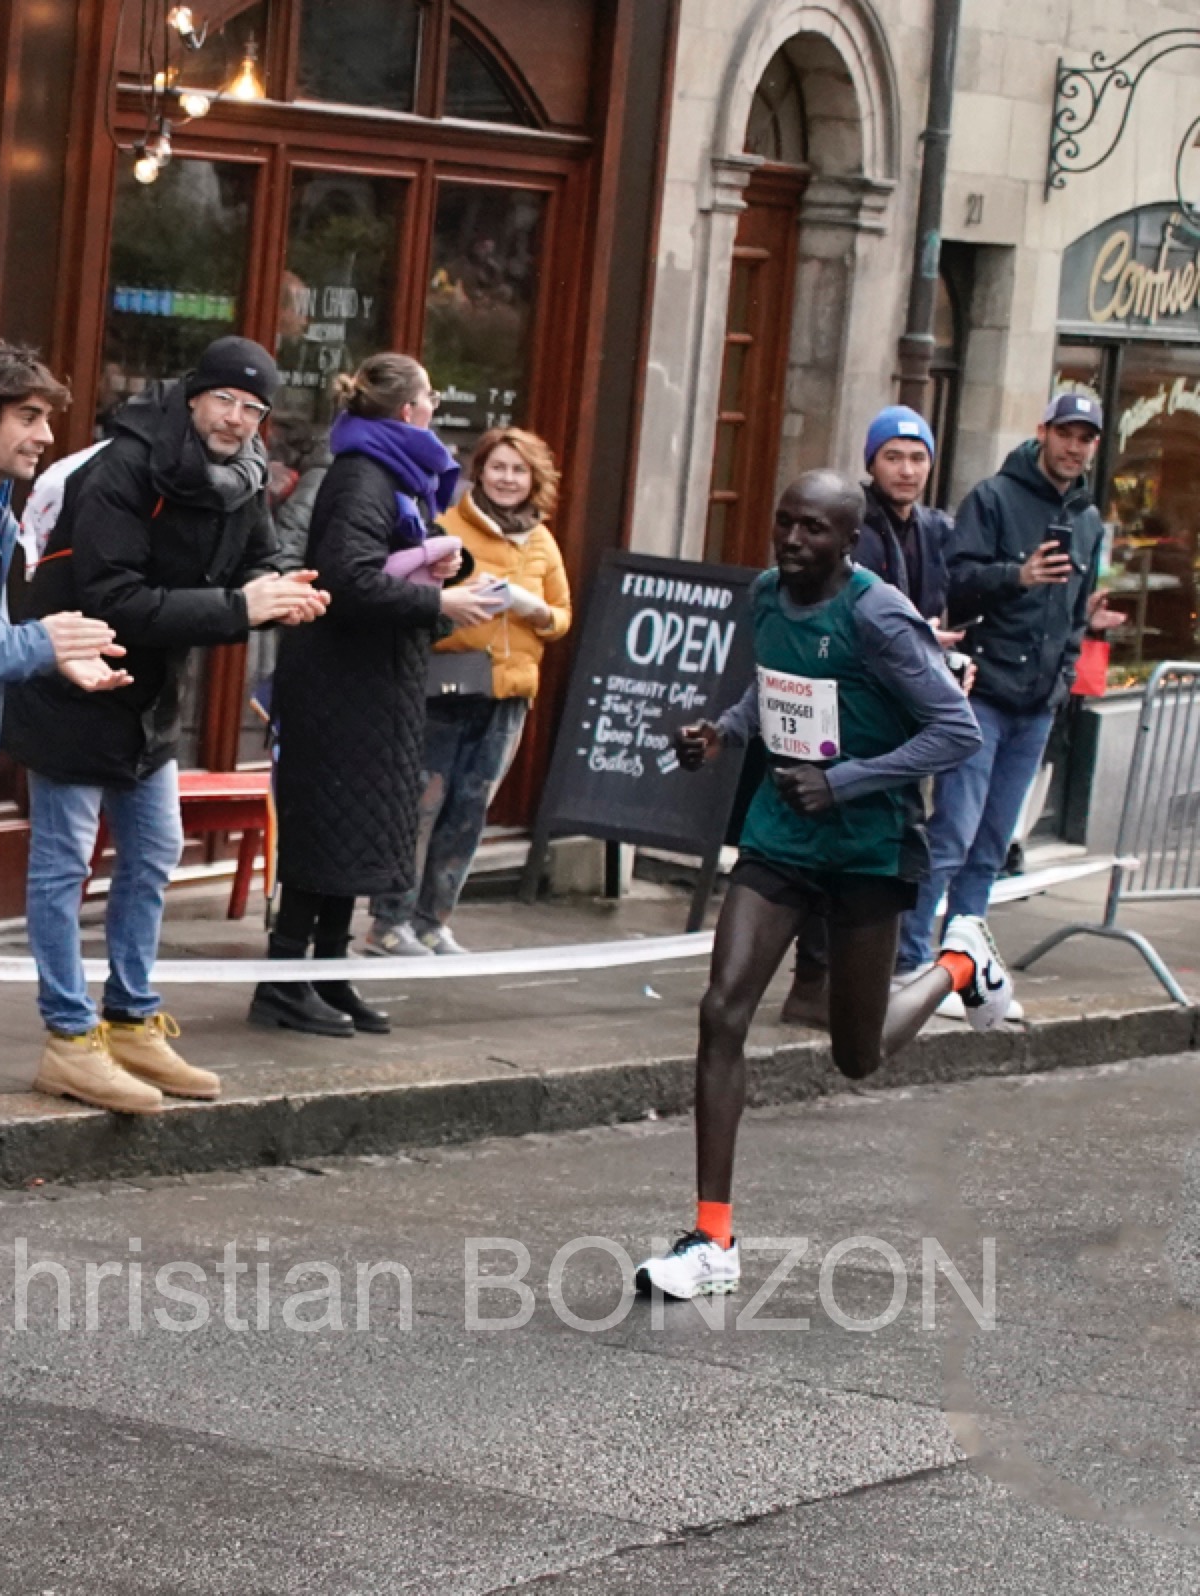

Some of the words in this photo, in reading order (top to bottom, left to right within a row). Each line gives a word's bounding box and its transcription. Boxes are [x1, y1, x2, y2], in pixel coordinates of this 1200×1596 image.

[966, 194, 984, 225] 21
[621, 573, 733, 610] FERDINAND
[626, 607, 737, 675] OPEN
[765, 676, 813, 697] MIGROS
[781, 715, 797, 735] 13
[783, 738, 811, 755] UBS
